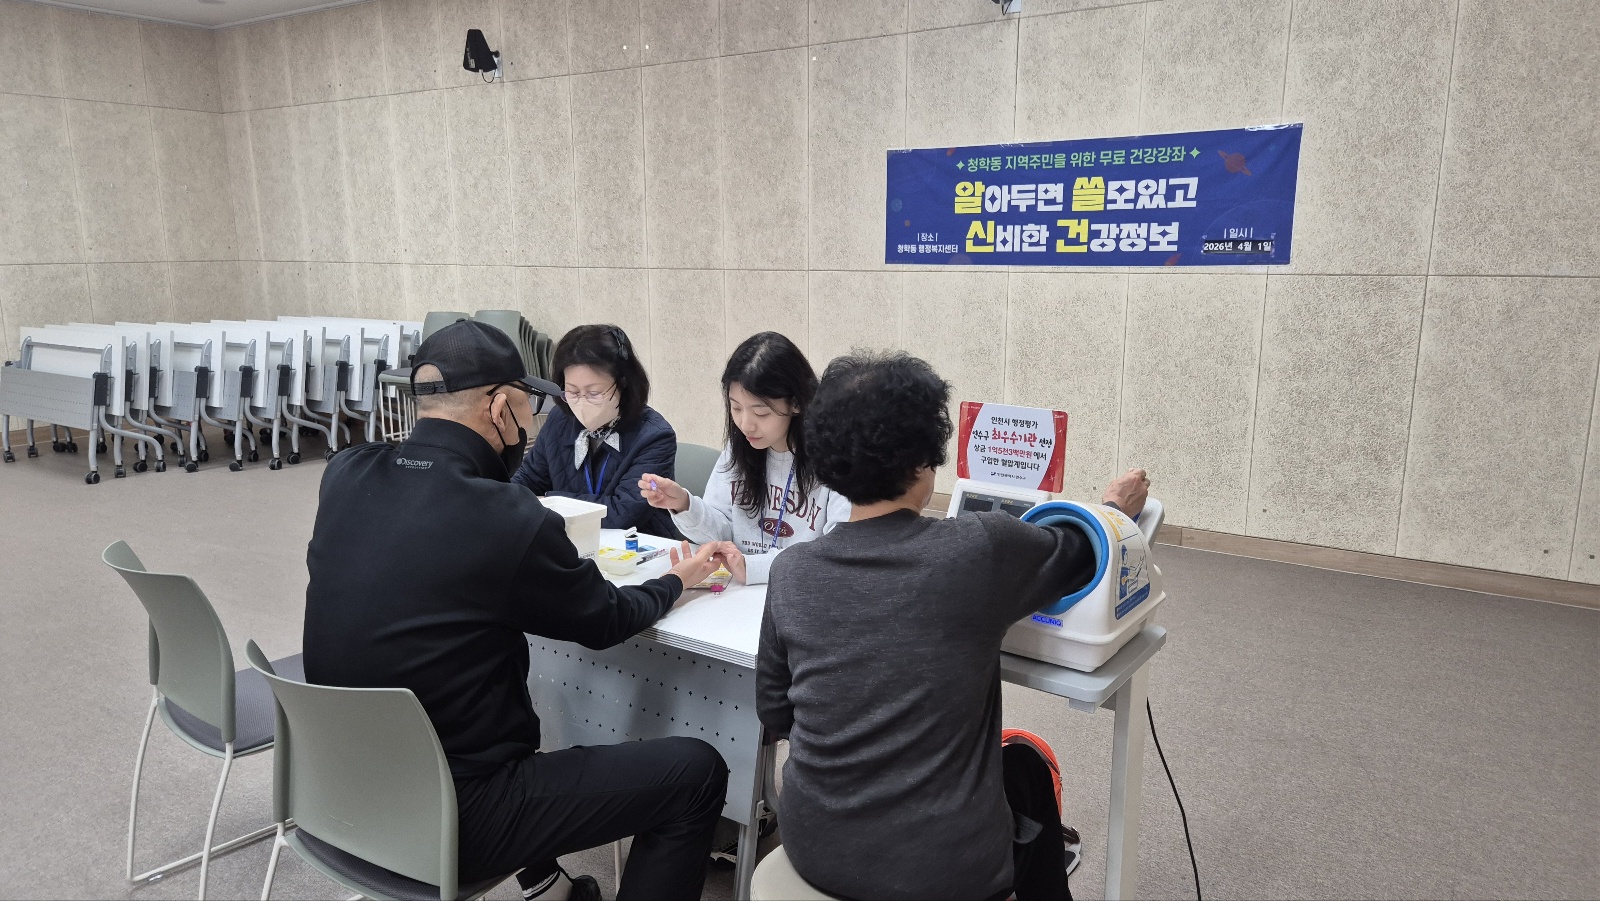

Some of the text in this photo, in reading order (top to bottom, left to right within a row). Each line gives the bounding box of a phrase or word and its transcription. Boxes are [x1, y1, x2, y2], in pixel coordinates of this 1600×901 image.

[968, 147, 1186, 172] 청학동 지역주민을 위한 무료 건강강좌
[955, 176, 1198, 214] 알아두면 쓸모있고
[966, 220, 1180, 253] 신비한 건강정보
[897, 244, 958, 253] 청학동 행정복지센터
[1204, 242, 1272, 251] 2026년 4월 1일
[991, 416, 1038, 429] 인천시 행정평가
[992, 427, 1037, 447] 최우수기관
[974, 444, 986, 453] 상금
[981, 456, 1040, 471] 구입한 혈압계입니다
